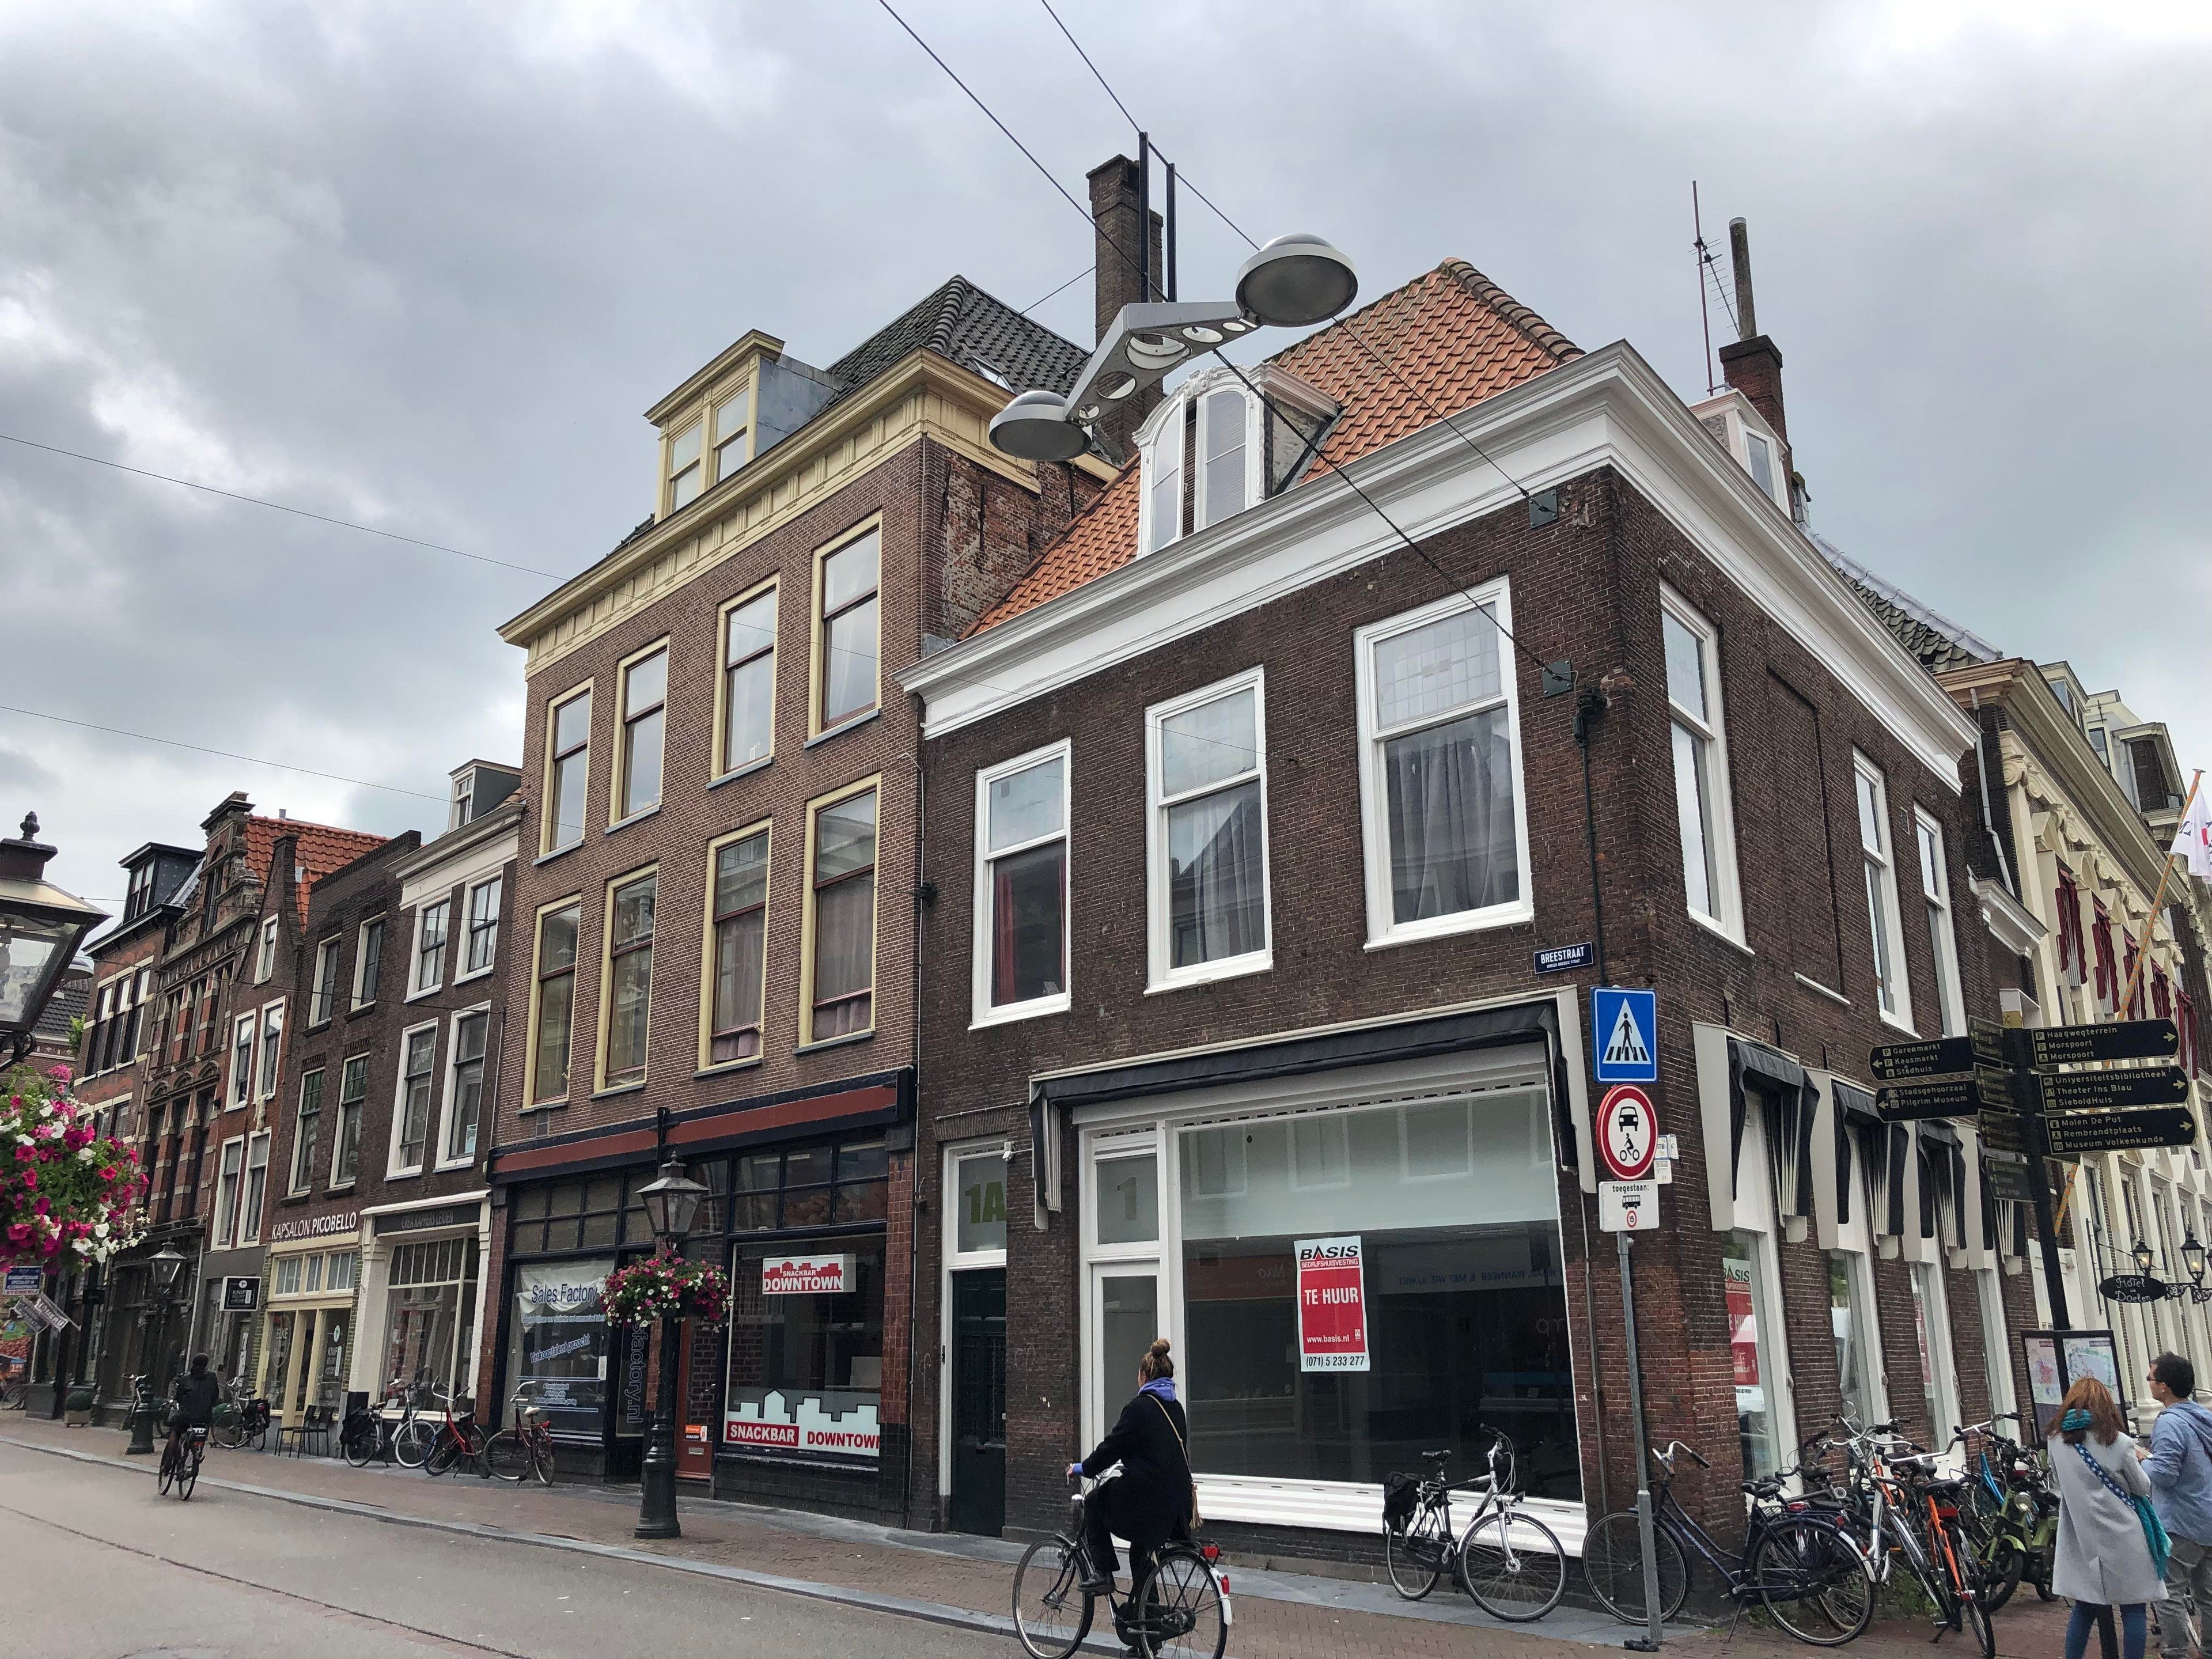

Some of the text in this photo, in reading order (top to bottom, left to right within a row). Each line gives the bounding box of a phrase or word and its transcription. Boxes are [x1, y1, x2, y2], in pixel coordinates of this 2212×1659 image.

[1540, 946, 1585, 964] BREESTRAAT
[2047, 1027, 2118, 1039] Haagwegterrein
[1893, 1043, 1941, 1055] Garenmarkt
[2048, 1039, 2093, 1050] Morspoort
[1895, 1054, 1939, 1065] Kaasmarkt
[2050, 1050, 2094, 1060] Morspoort
[1896, 1066, 1933, 1075] Stadhuis
[2055, 1070, 2167, 1084] Universiteitsbibliotheek
[1899, 1084, 1967, 1096] Stadsgehoorzaal
[2056, 1085, 2091, 1094] Theater
[2111, 1084, 2132, 1092] Blau
[1901, 1099, 1931, 1107] Pilgrim
[2058, 1096, 2113, 1106] SieboldHuis
[2062, 1118, 2088, 1127] Molen
[2063, 1126, 2142, 1138] Rembrandtplaats
[2065, 1136, 2164, 1148] Museum Volkenkunde
[1612, 1184, 1650, 1194] toegestaan:
[965, 1181, 1006, 1224] 1A
[1116, 1176, 1137, 1221] 1
[272, 1211, 357, 1240] KAPSALON PICOBELLO
[1300, 1244, 1358, 1260] BASIS
[1301, 1258, 1358, 1268] BEDRIJFSHUISVESTING
[763, 1276, 843, 1291] DOWNTOWN
[531, 1283, 598, 1308] Sales Factory
[1304, 1287, 1359, 1305] TE HUUR
[2115, 1290, 2153, 1302] Doelen
[1306, 1334, 1350, 1343] www.basis.nl
[529, 1333, 590, 1364] Verkooptalent gezocht
[1306, 1355, 1365, 1368] (071) 5 233 277
[624, 1323, 648, 1423] sfactory.nl
[730, 1424, 795, 1443] SNACKBAR
